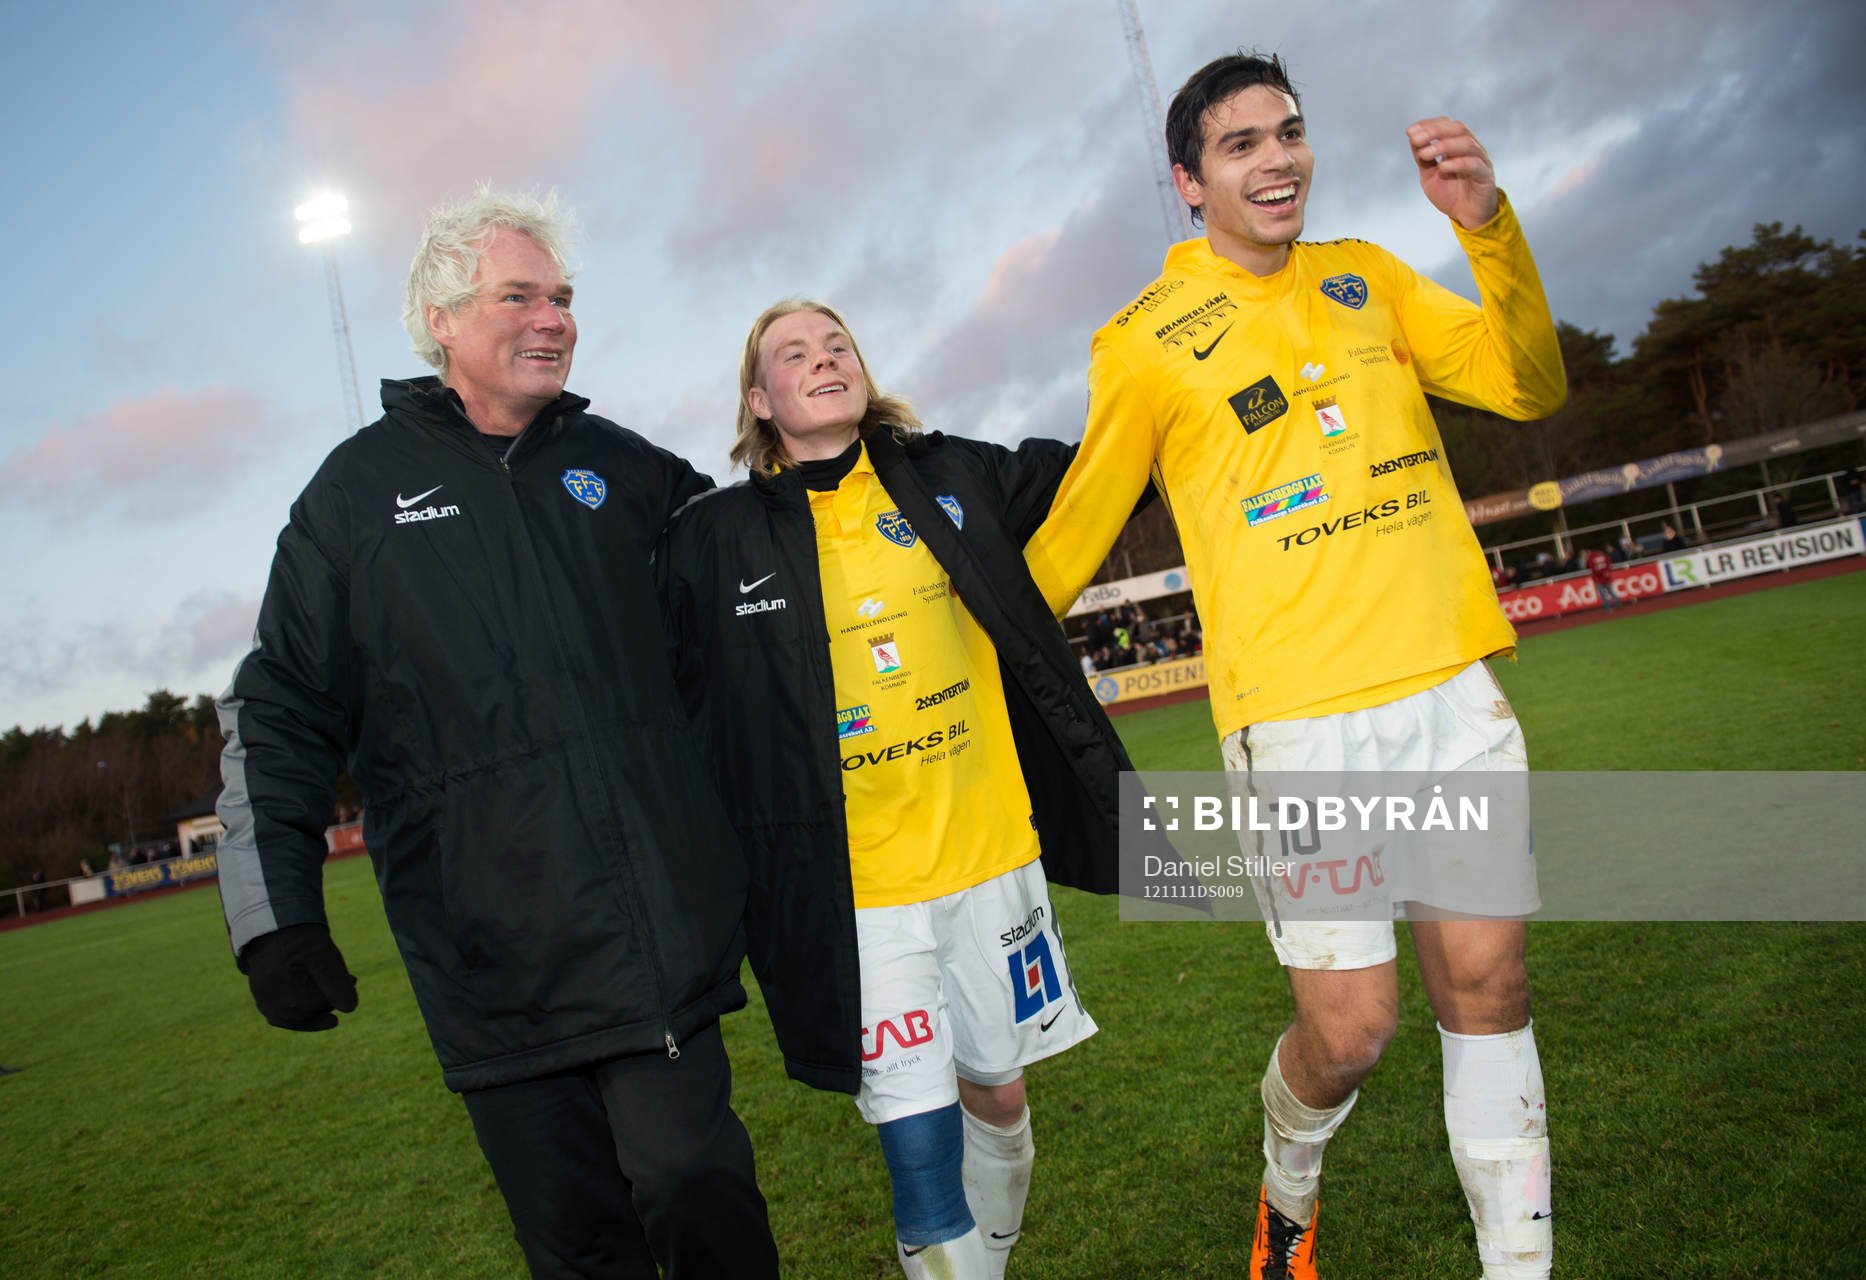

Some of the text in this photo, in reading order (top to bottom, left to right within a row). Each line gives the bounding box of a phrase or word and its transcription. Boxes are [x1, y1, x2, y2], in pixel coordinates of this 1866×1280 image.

[1242, 396, 1285, 426] FALCON
[1241, 474, 1325, 512] FALKENBERGS LAX
[394, 505, 461, 524] stadium
[1276, 490, 1431, 552] TOVEKS BIL
[1376, 520, 1404, 537] Hela
[1704, 552, 1737, 577] LR
[1743, 528, 1855, 571] REVISION
[735, 598, 787, 616] stadium
[1502, 595, 1543, 621] cco
[852, 705, 870, 720] LAX
[841, 719, 970, 772] OVEKS BIL
[920, 751, 946, 767] Hela
